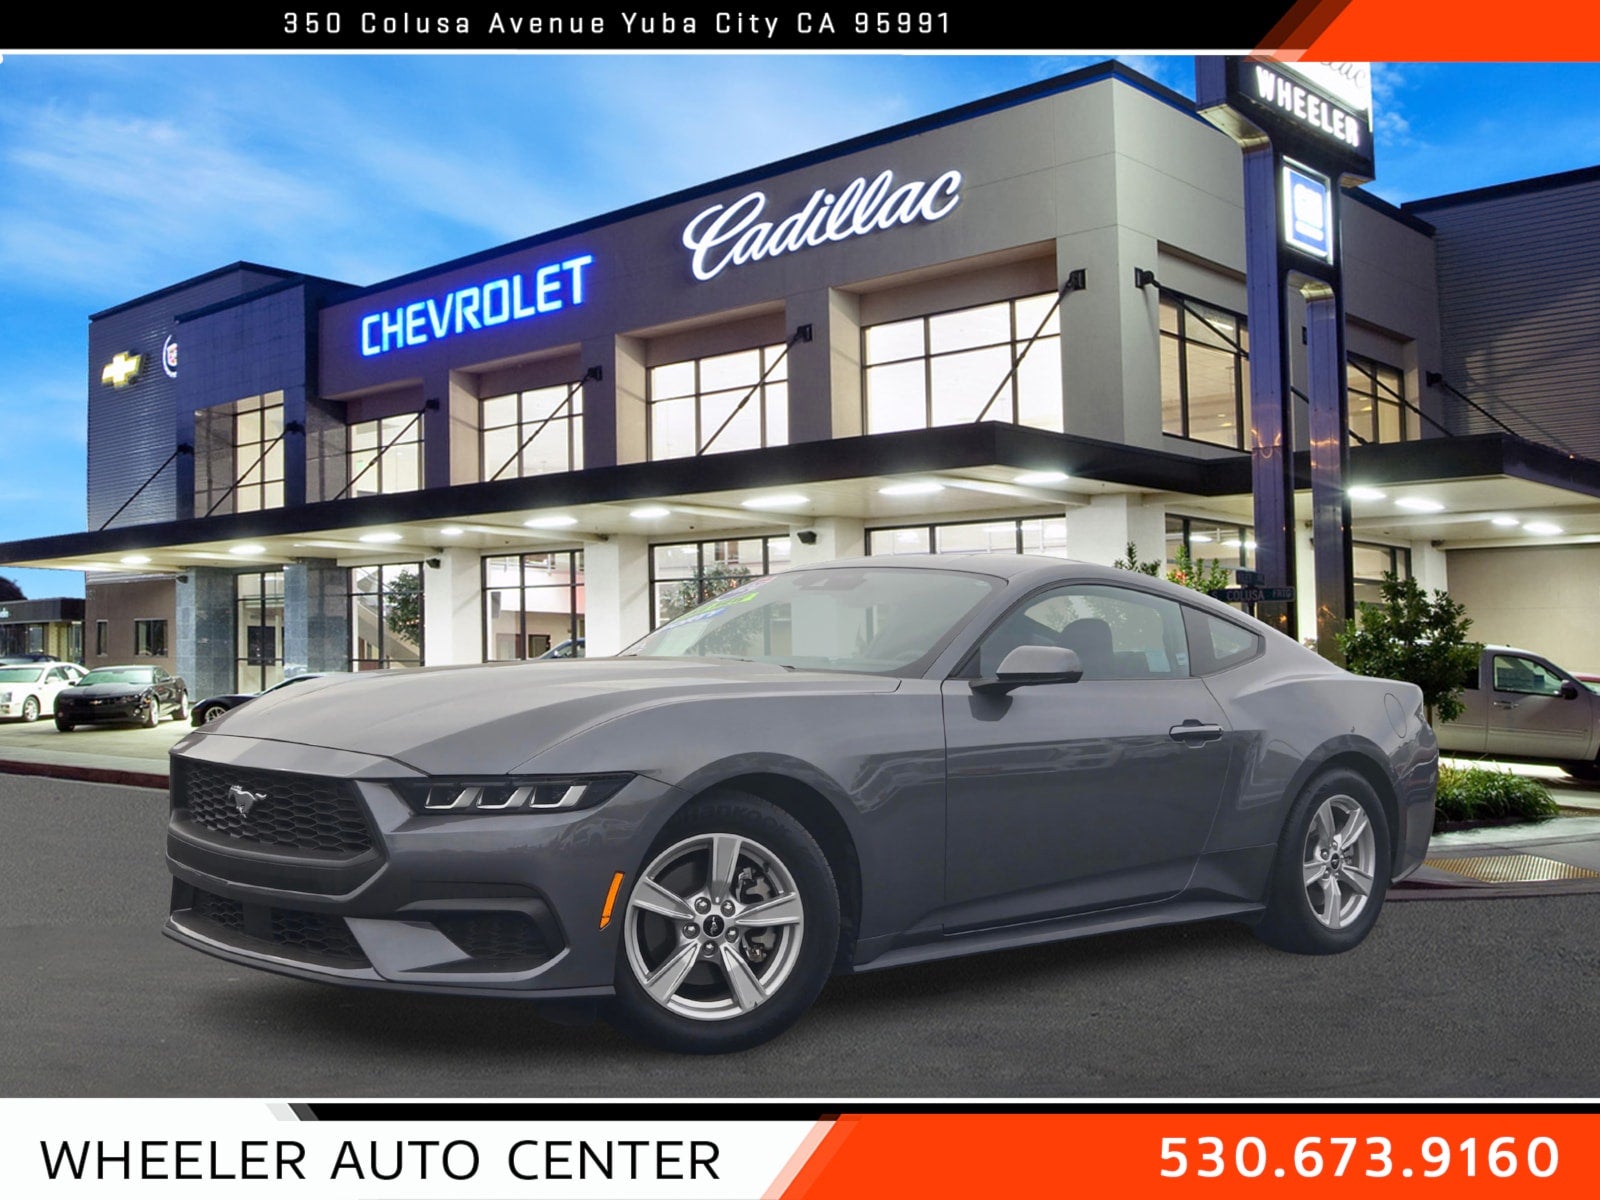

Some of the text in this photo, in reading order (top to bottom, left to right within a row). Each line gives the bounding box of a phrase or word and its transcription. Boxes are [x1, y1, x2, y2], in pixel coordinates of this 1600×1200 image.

[1255, 65, 1360, 147] WHEELER
[682, 169, 962, 281] Cadillac
[361, 254, 593, 357] CHEVROLET
[1226, 590, 1265, 601] COLUSA
